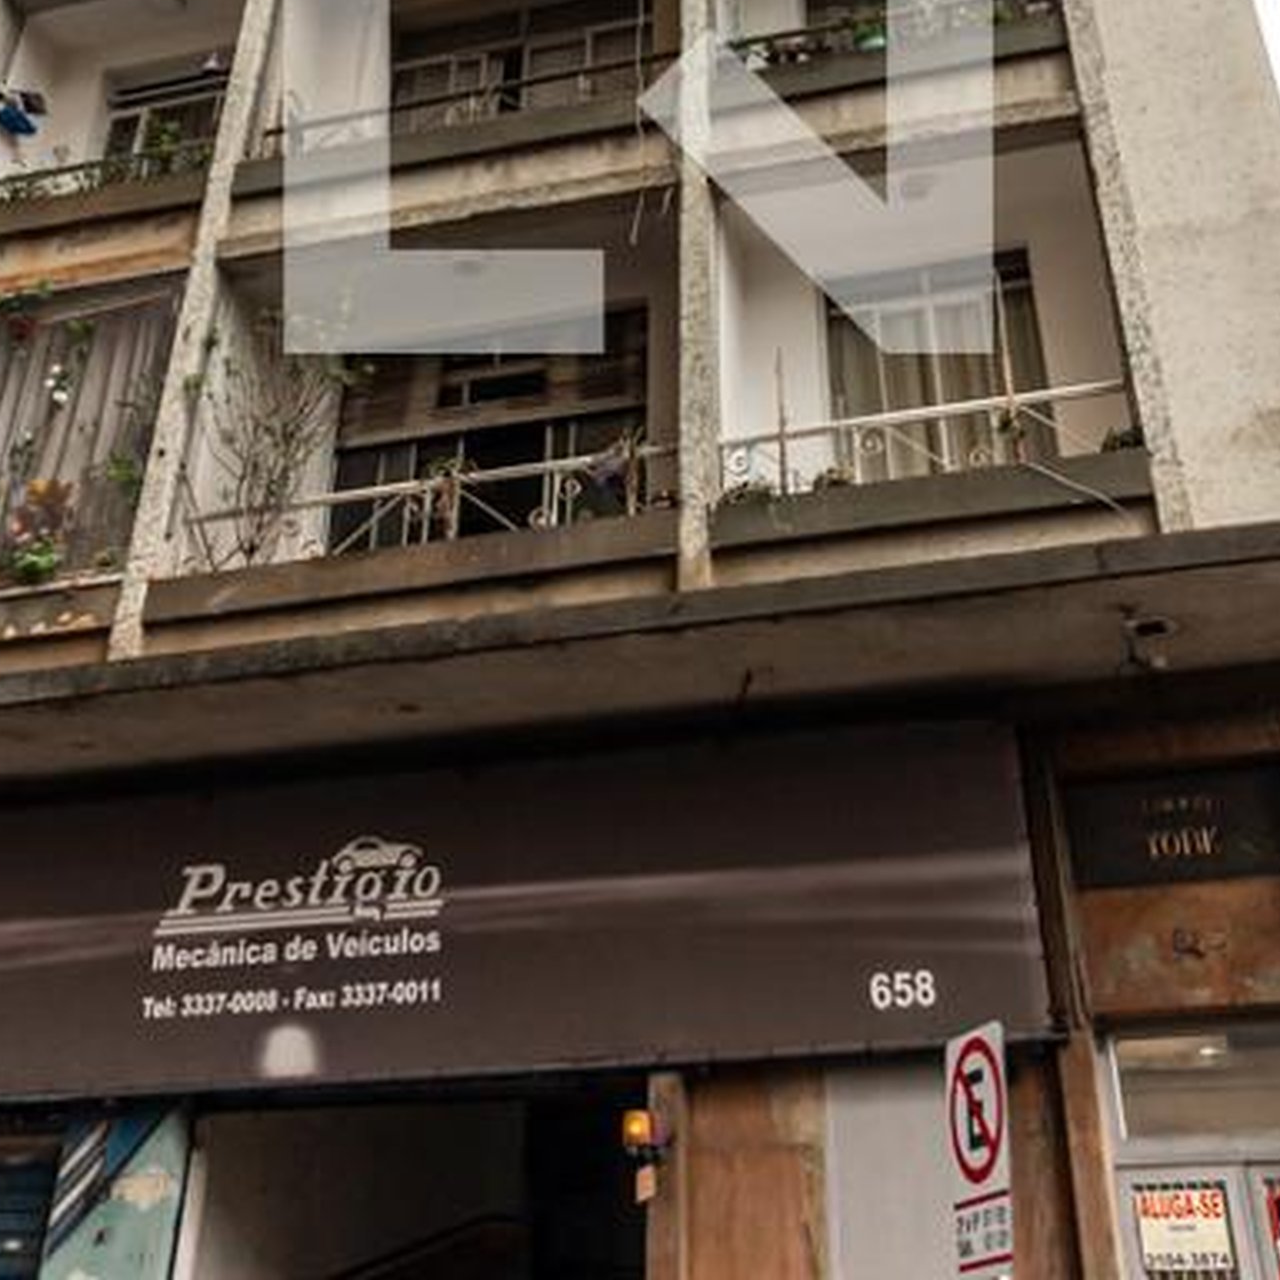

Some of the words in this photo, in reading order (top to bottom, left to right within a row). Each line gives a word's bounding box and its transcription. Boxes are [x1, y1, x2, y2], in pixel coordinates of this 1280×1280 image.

[284, 935, 319, 962] de
[340, 979, 442, 1007] 3337-0011
[870, 970, 936, 1009] 658
